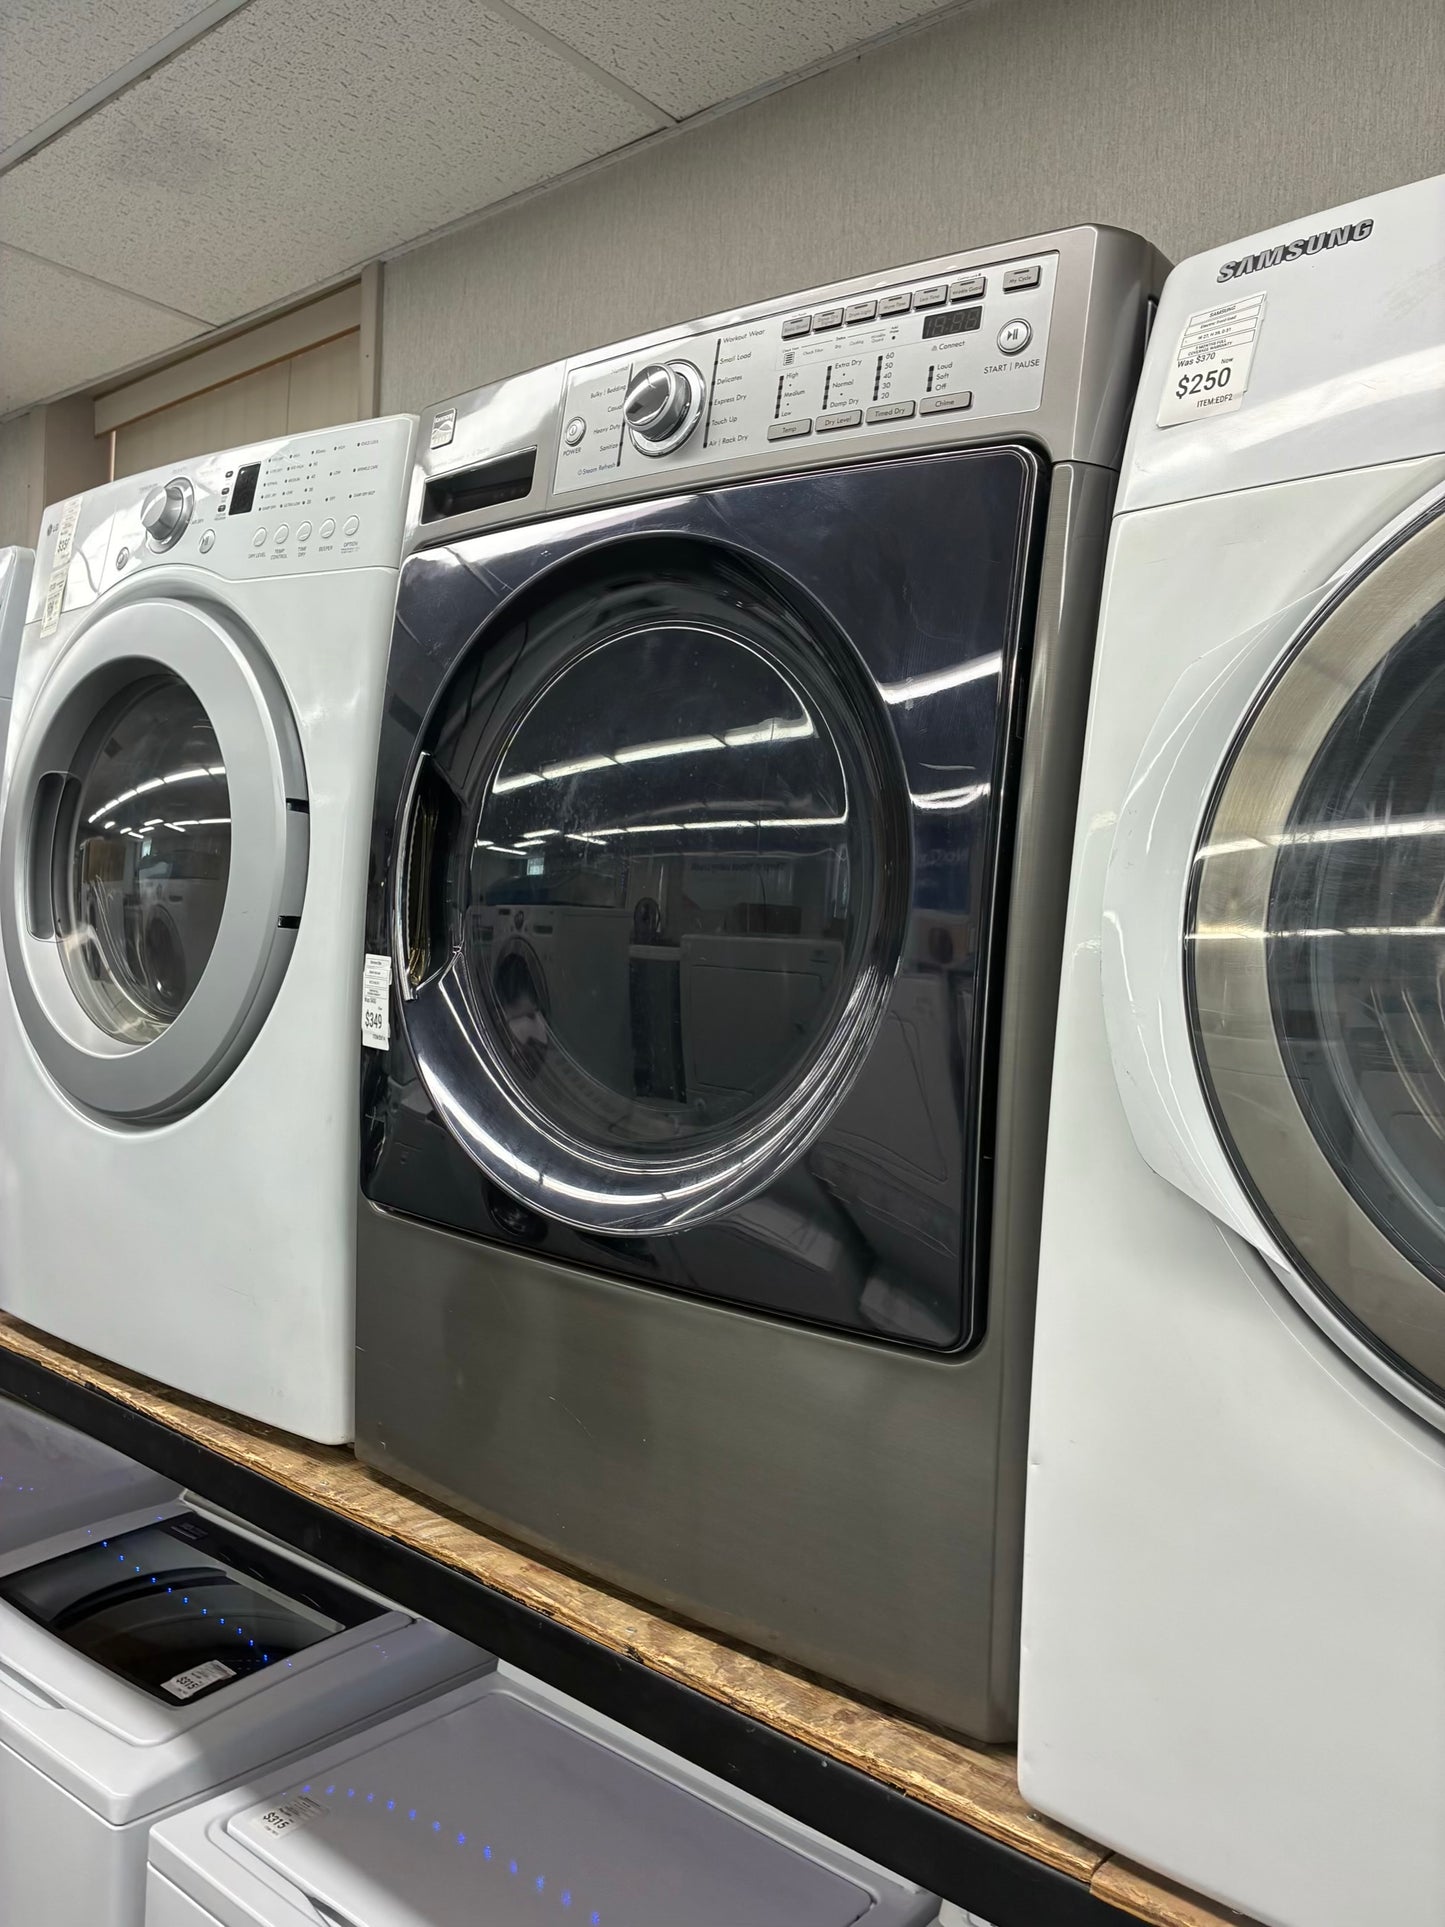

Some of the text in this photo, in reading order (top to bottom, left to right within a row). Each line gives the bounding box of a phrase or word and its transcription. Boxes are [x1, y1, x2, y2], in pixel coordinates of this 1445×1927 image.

[1216, 219, 1374, 283] SAMSUNG
[1018, 275, 1032, 283] Cycle
[1209, 305, 1236, 318] SAMSUNG
[723, 329, 765, 343] Workout Wear
[939, 341, 965, 350] Connect
[719, 352, 752, 365] Small Load
[885, 352, 895, 360] 60
[1178, 352, 1216, 368] Was $370
[835, 359, 863, 369] Extra Dry
[884, 362, 894, 370] 50
[937, 362, 953, 370] Loud
[983, 364, 1007, 375] START
[1014, 358, 1040, 370] PAUSE
[716, 375, 742, 385] Delicates
[786, 372, 799, 380] High
[832, 379, 854, 388] Normal
[882, 382, 891, 390] 30
[935, 383, 947, 391] Off
[1176, 367, 1231, 399] $250
[590, 391, 602, 399] Bulky
[607, 385, 626, 395] Bedding
[784, 390, 806, 398] Medium
[714, 394, 747, 406] Express Dry
[935, 400, 954, 408] Chime
[1196, 393, 1233, 408] ITEM:EDF2
[875, 407, 906, 417] Timed Dry
[712, 417, 728, 426] Touch
[836, 416, 852, 424] Level
[593, 427, 608, 435] Heavy
[722, 436, 736, 444] Rack
[737, 434, 748, 442] Dry
[563, 447, 581, 456] POWER
[599, 443, 618, 452] Sanitize
[582, 463, 616, 475] Steam Refresh
[365, 1009, 383, 1029] $349
[262, 1811, 290, 1829] $315
